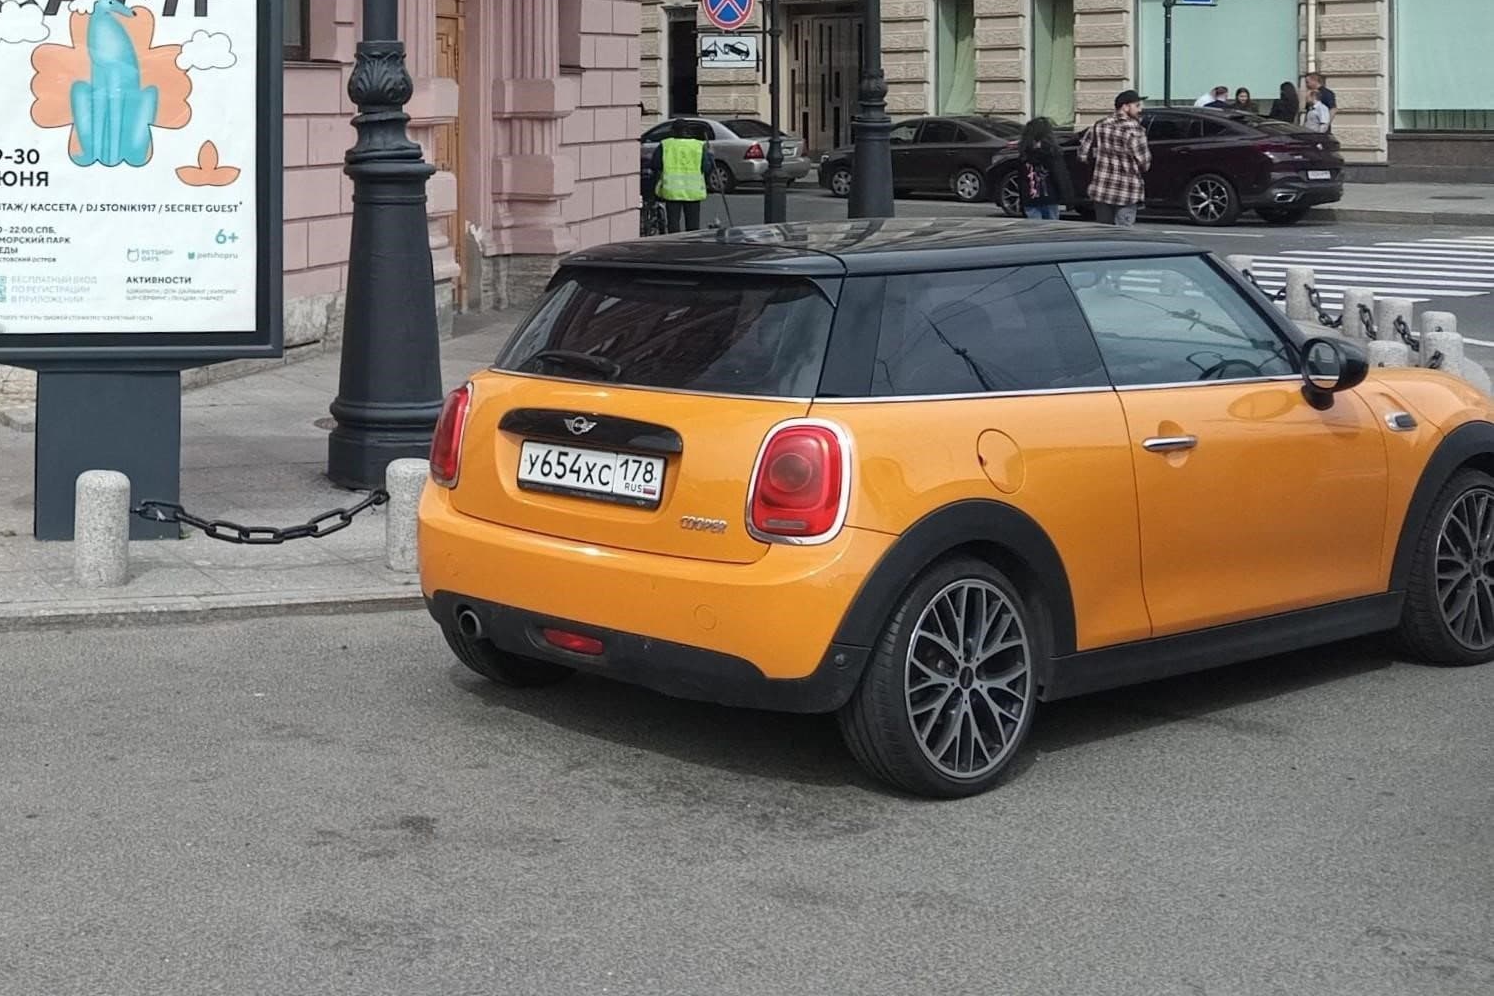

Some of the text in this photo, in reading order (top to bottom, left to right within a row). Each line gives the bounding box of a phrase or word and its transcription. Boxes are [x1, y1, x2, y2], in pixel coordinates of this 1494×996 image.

[30, 203, 77, 212] КАССЕТА
[86, 204, 98, 212] DJ
[99, 203, 156, 212] STONIK1917
[164, 204, 204, 213] SECRET
[205, 204, 239, 213] GUEST
[46, 236, 71, 244] ПАРК
[215, 228, 239, 245] 6+
[126, 276, 192, 285] АКТИВНОСТИ
[527, 450, 654, 486] У654ХС 178
[624, 482, 642, 493] RUS
[680, 515, 728, 534] COOPER
